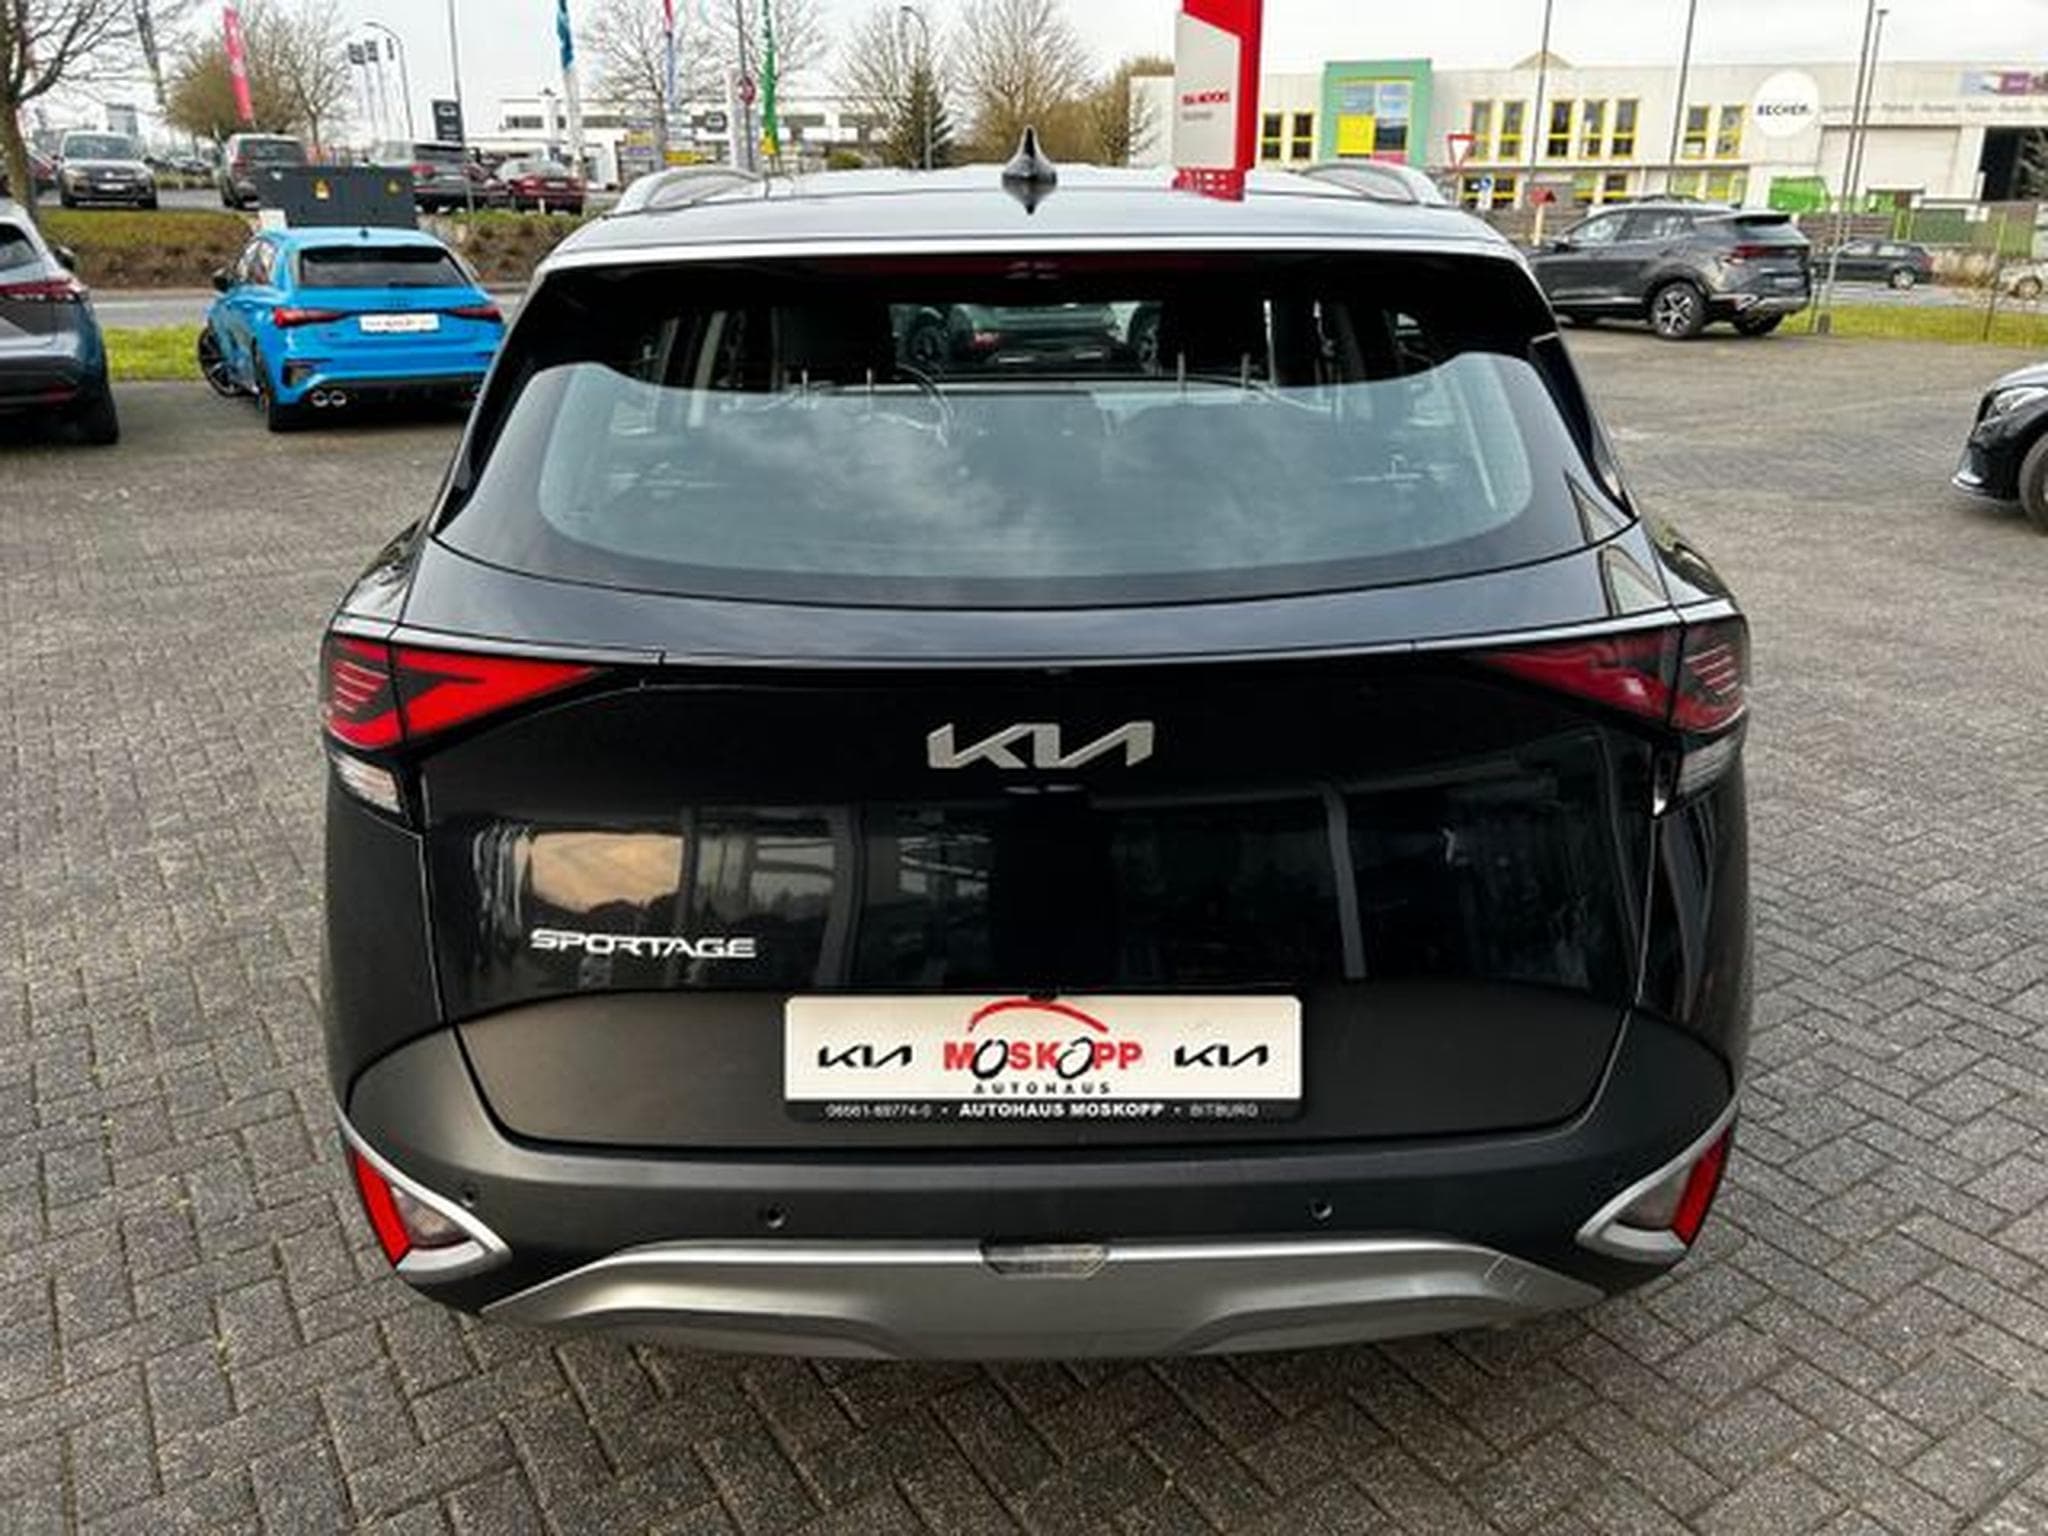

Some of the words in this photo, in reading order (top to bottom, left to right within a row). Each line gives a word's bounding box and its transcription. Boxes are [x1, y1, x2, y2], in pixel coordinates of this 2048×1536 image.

[927, 721, 1154, 768] KIA
[531, 928, 755, 957] SPORTAGE
[818, 1045, 912, 1068] KIA
[943, 1036, 1143, 1079] MOSKOPP
[1174, 1044, 1268, 1068] KIA
[974, 1082, 1110, 1095] AUTOHAUS
[959, 1103, 1065, 1118] AUTOHAUS
[1069, 1103, 1164, 1118] MOSKOPP
